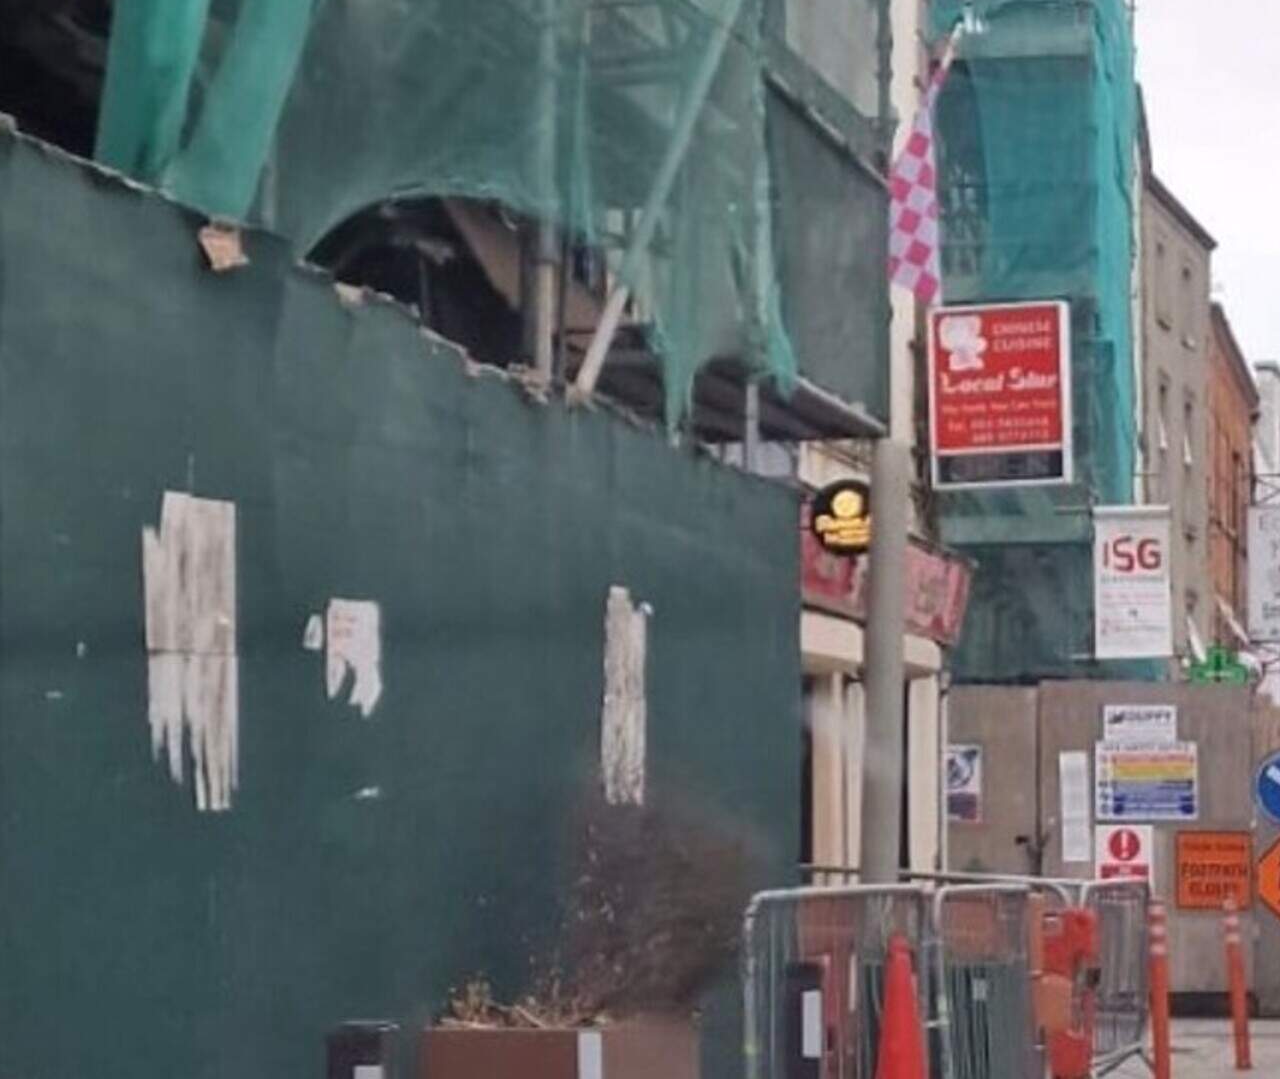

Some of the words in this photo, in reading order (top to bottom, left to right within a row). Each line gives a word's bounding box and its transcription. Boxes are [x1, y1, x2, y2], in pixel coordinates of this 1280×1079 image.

[991, 336, 1052, 352] CUISINE
[939, 371, 1005, 393] Local
[1006, 366, 1057, 390] Star
[1102, 535, 1162, 572] ISG
